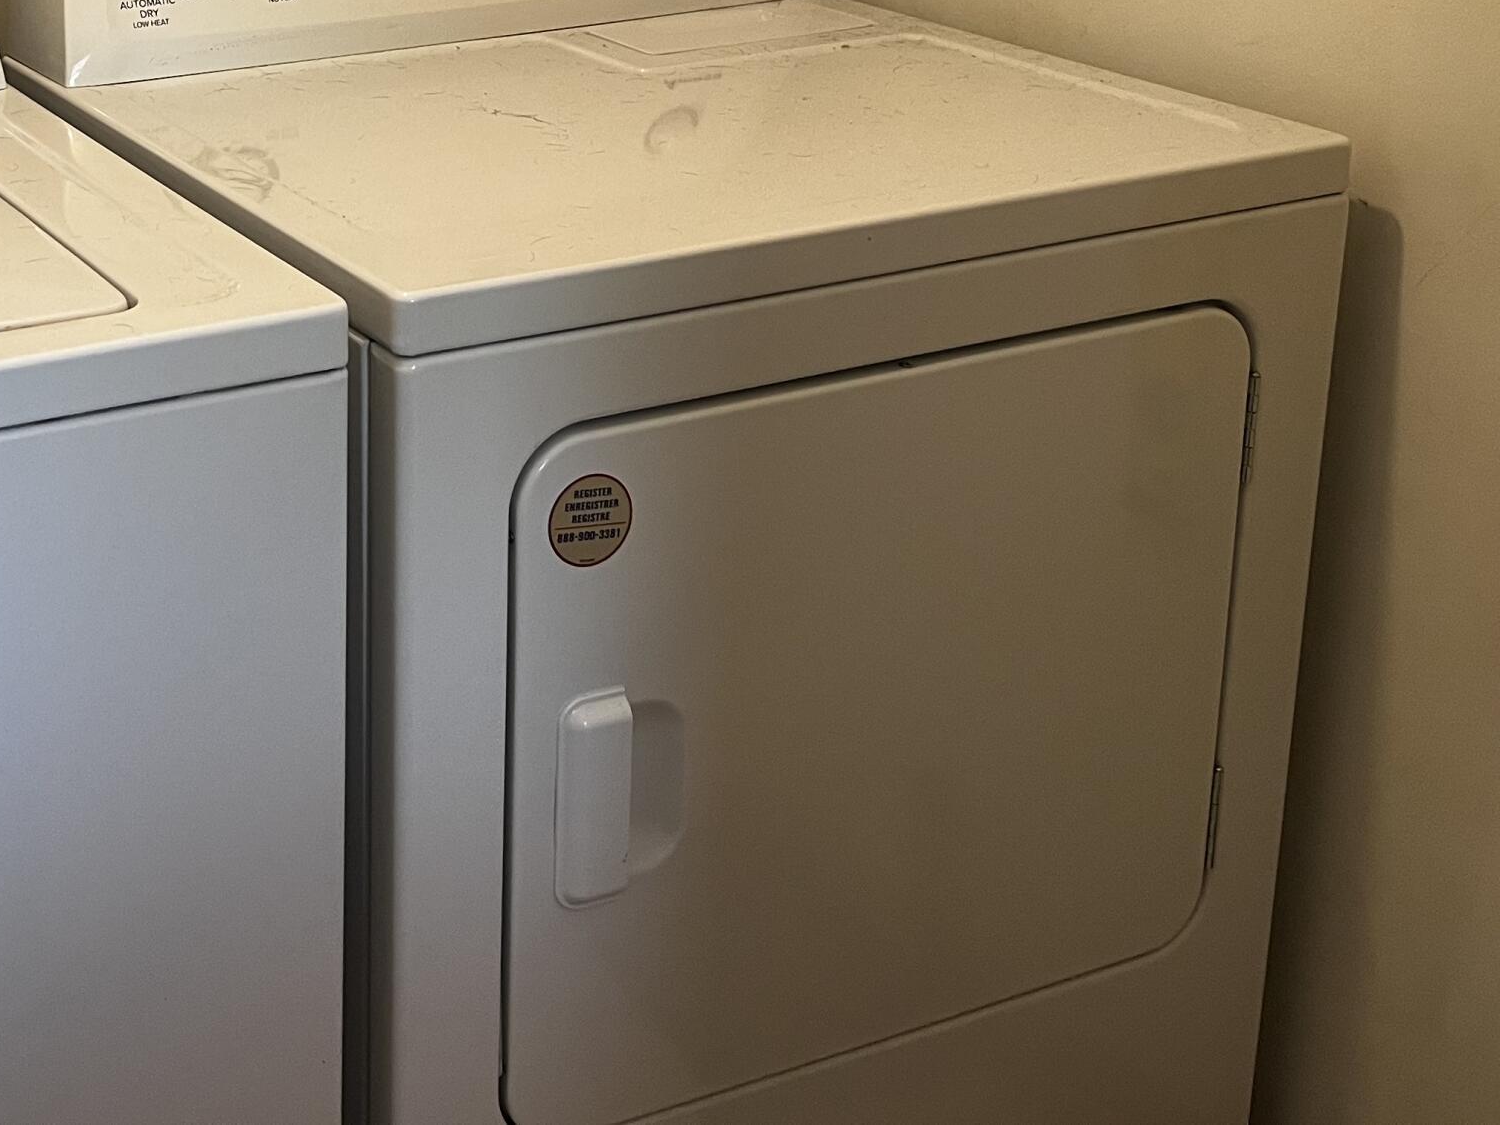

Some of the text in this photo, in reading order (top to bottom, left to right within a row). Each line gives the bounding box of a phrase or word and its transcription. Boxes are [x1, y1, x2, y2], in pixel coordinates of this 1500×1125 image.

[140, 9, 159, 18] DRY
[151, 18, 170, 26] HEAT
[574, 487, 612, 499] REGISTER
[565, 499, 619, 512] ENREGISTRER
[572, 512, 611, 523] REGISTRE
[557, 528, 621, 544] 888-900-3381
